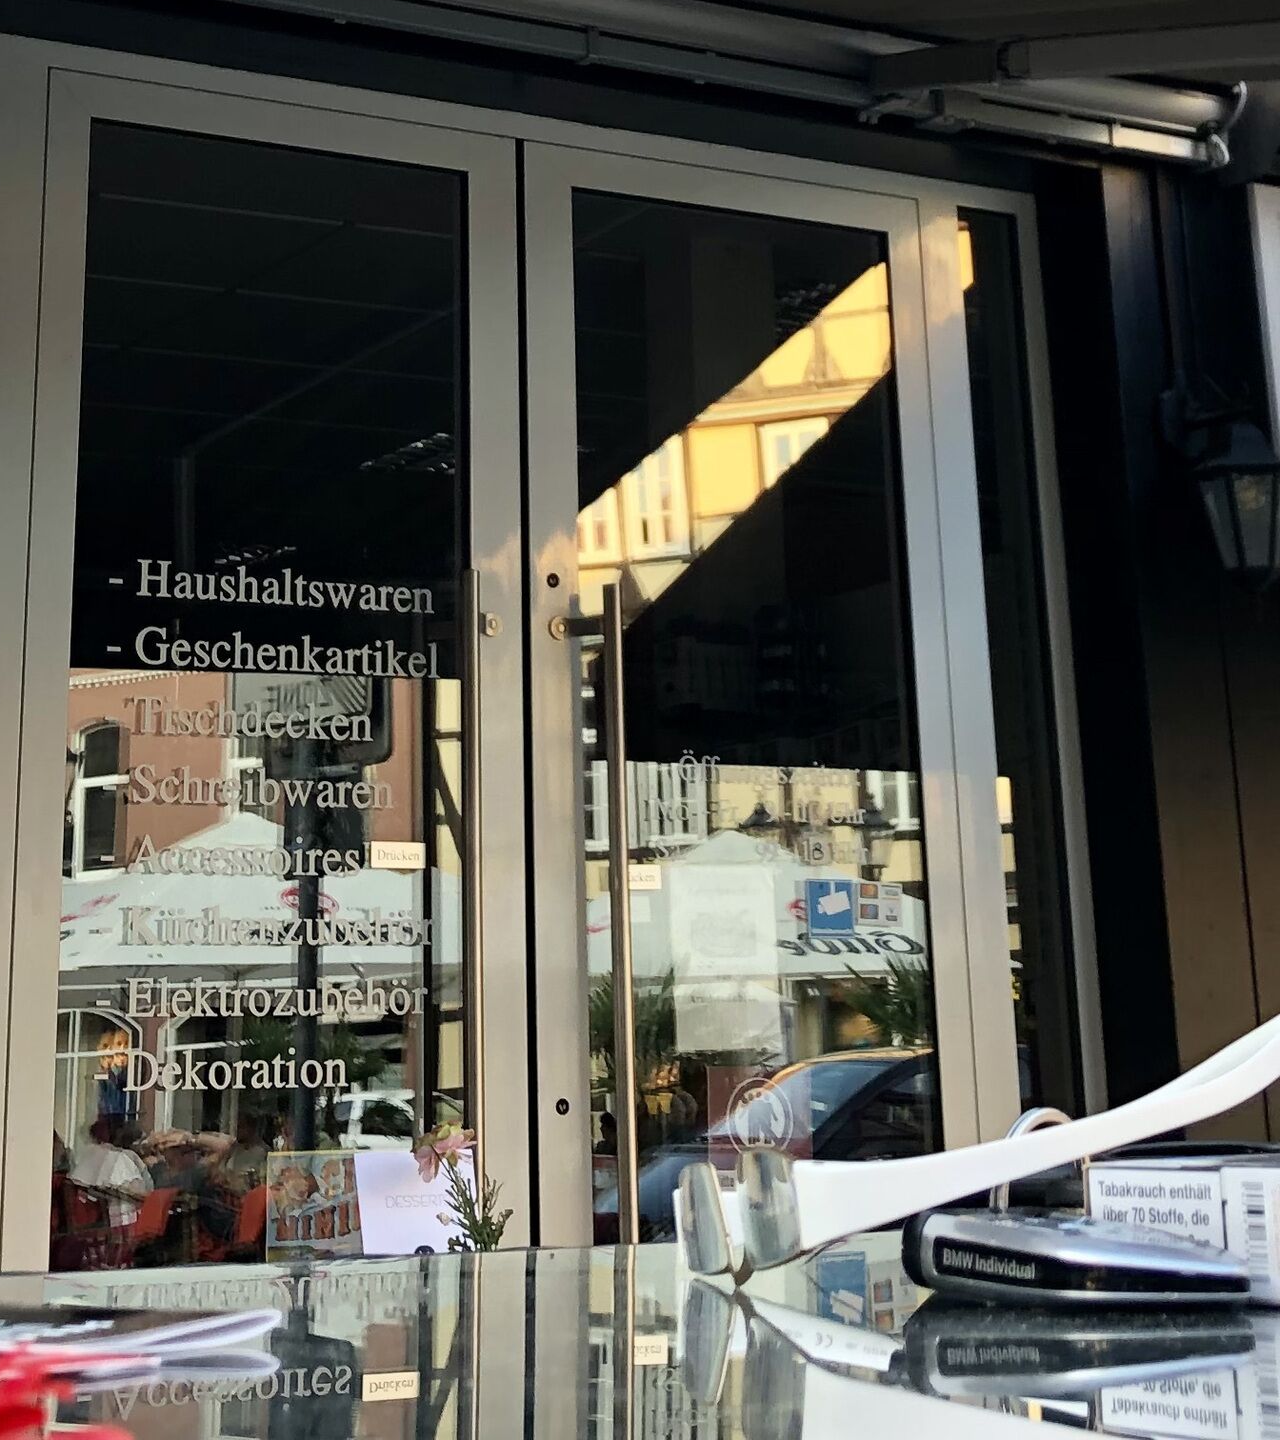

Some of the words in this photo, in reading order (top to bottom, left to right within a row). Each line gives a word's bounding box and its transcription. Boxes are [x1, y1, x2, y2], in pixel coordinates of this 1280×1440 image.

[136, 559, 435, 614] Haushaltswaren
[135, 626, 441, 679] Geschenkartikel
[131, 696, 373, 742] Tischdecken
[133, 765, 394, 809] Schreibwaren
[125, 834, 361, 879] Accessoires
[377, 847, 420, 862] Drücken
[121, 906, 434, 948] Küchenzubehör
[126, 977, 429, 1018] Elektrozubehör
[123, 1048, 348, 1092] Dekoration
[1098, 1180, 1166, 1199] Tabakrauch
[1169, 1182, 1212, 1201] enthält
[1103, 1204, 1128, 1222] über
[1132, 1206, 1145, 1223] 70
[1148, 1206, 1188, 1228] Stoffe,
[1191, 1208, 1210, 1226] die
[942, 1246, 975, 1270] BMW
[975, 1253, 1036, 1280] Individual
